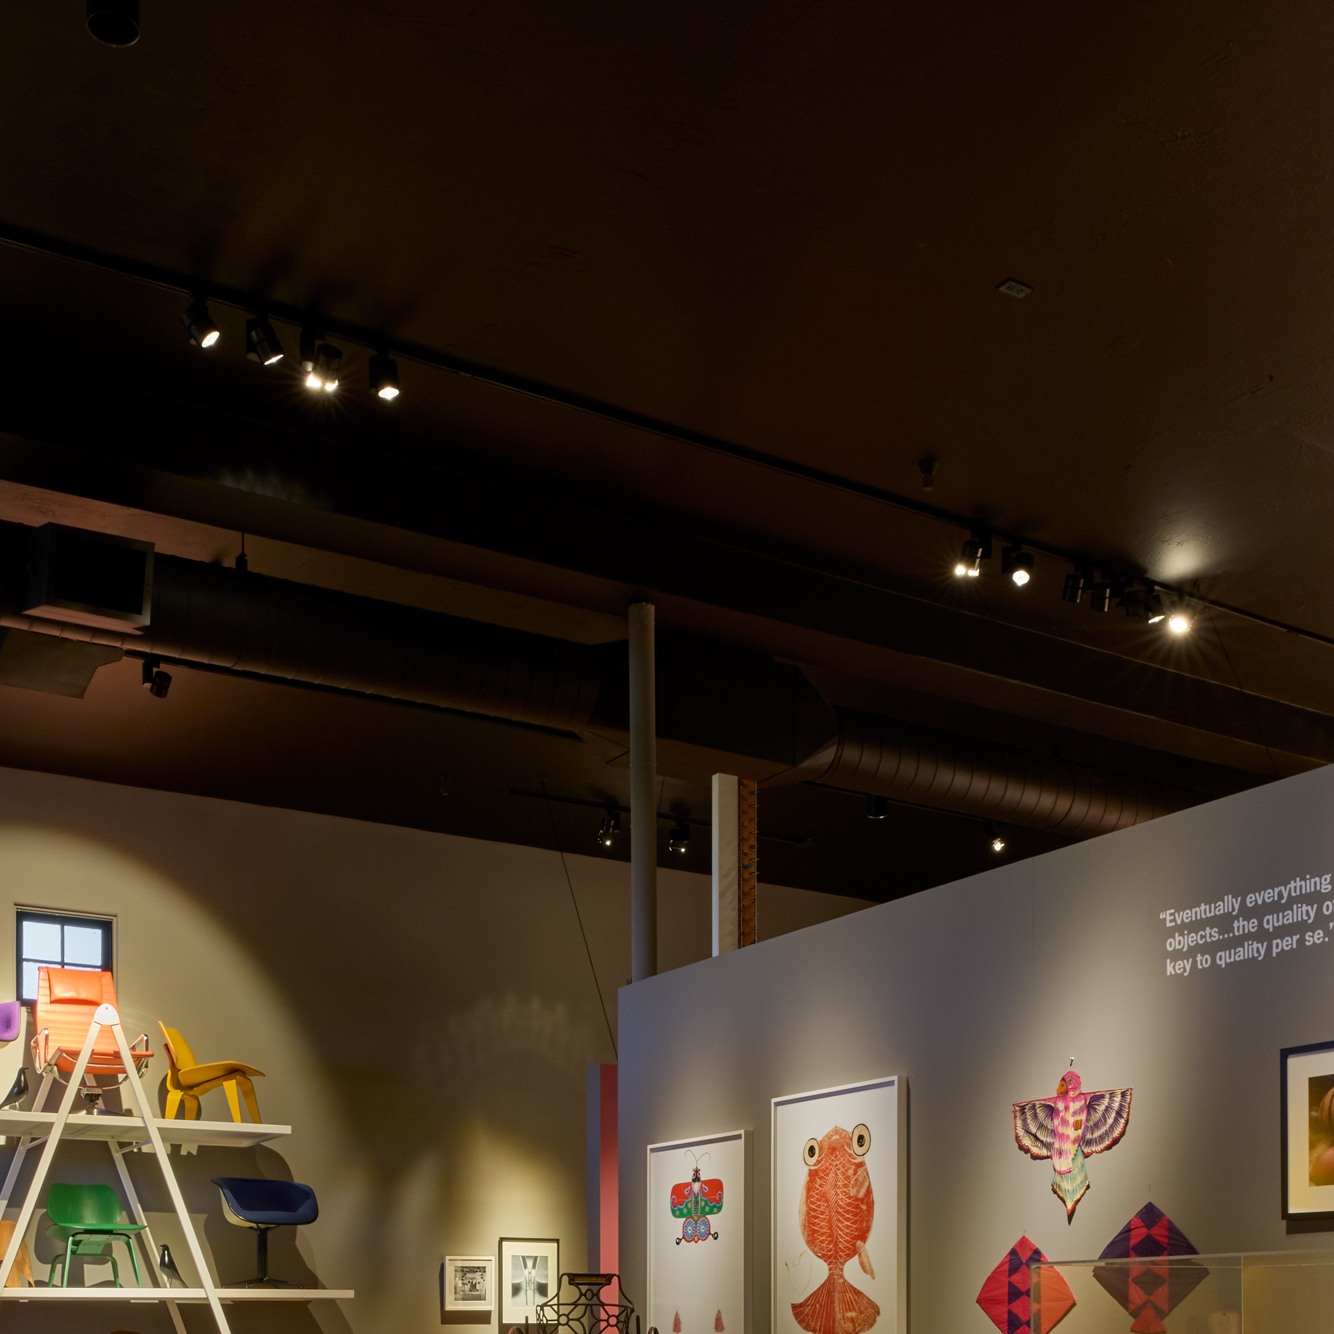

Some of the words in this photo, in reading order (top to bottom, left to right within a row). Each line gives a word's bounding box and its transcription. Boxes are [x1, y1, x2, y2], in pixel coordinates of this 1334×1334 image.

[1246, 872, 1331, 908] everything
[1263, 901, 1317, 934] quality
[1166, 957, 1192, 976] key
[1197, 951, 1211, 968] to
[1216, 939, 1267, 968] quality
[1272, 934, 1300, 956] per
